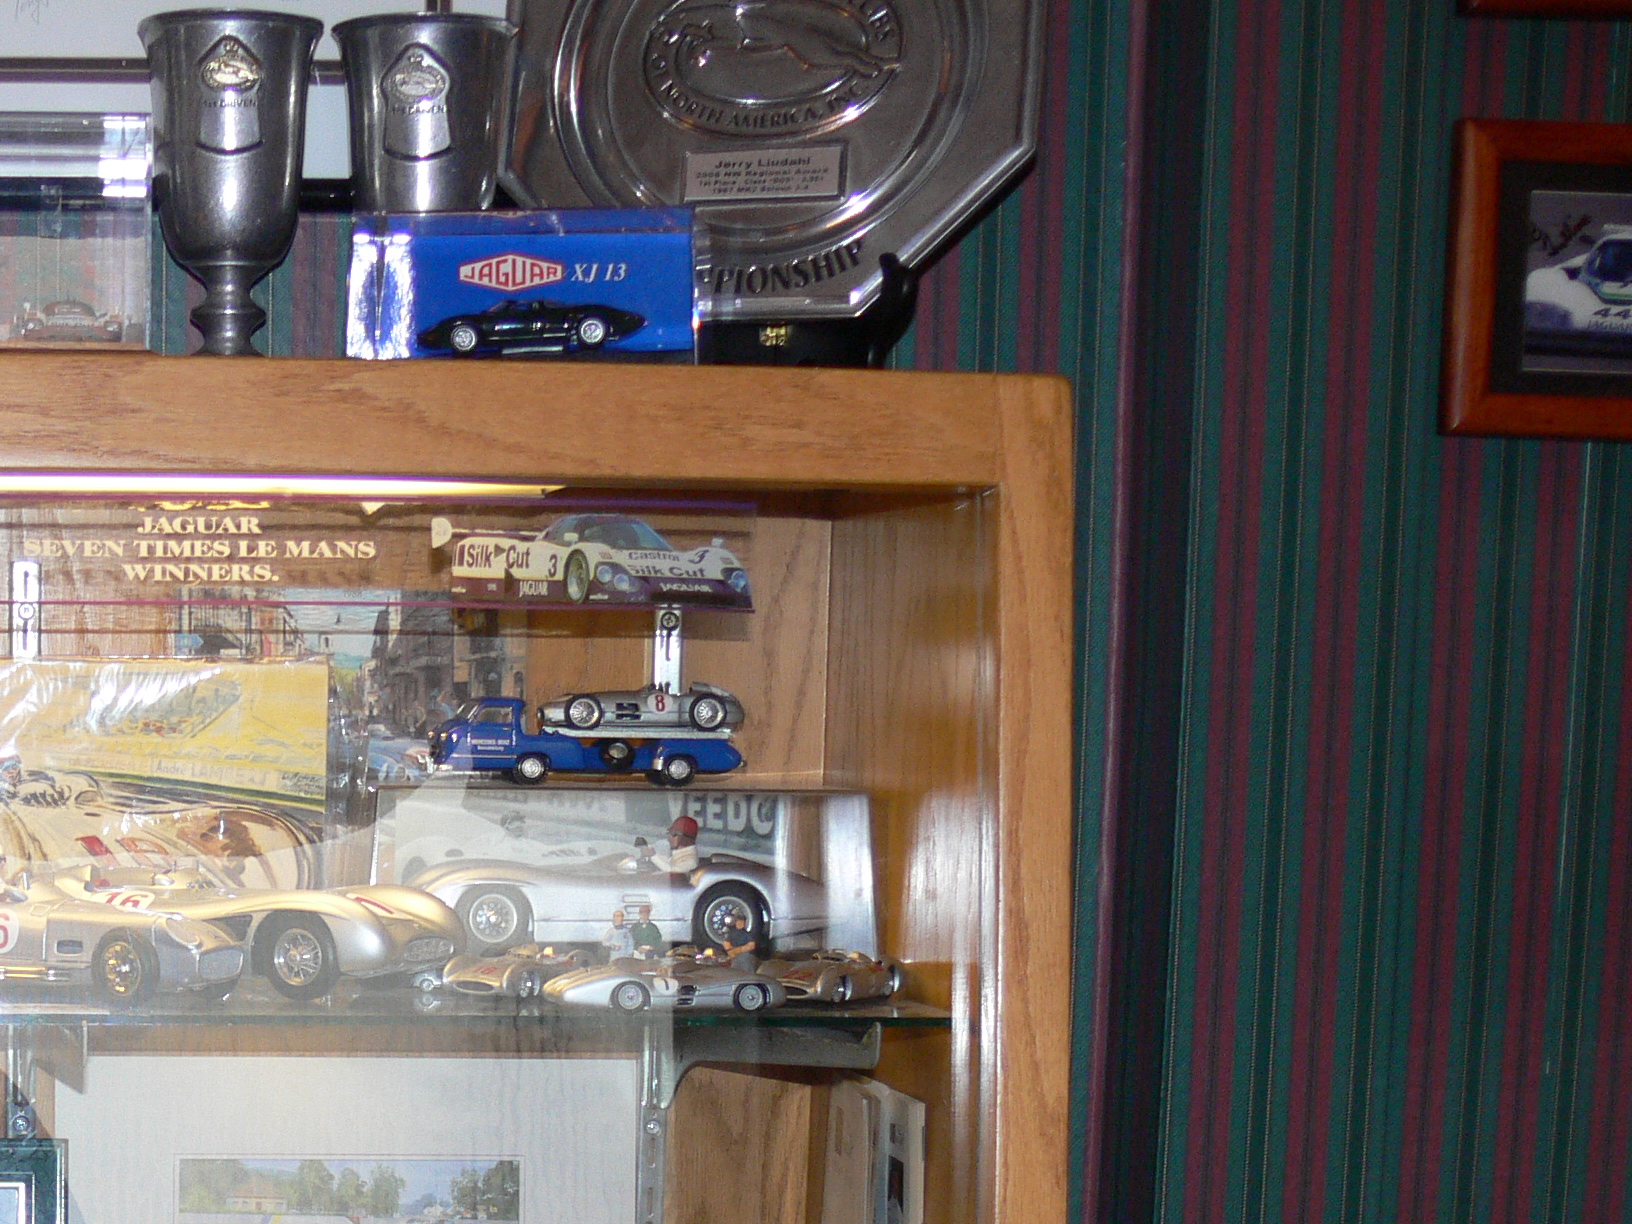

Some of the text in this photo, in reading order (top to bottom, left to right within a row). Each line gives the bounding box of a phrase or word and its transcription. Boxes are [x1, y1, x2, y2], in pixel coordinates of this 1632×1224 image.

[714, 158, 754, 170] Jerry
[462, 255, 628, 290] JAGUAR XJ 13
[1594, 307, 1632, 319] 44
[136, 516, 263, 535] JAGUAR
[23, 538, 377, 559] SEVEN TIMES LE MANS
[465, 543, 559, 577] Silk Cut 3
[120, 562, 281, 584] WINNERS.
[668, 564, 707, 579] Cut
[518, 580, 549, 599] JAGUAR
[655, 694, 667, 713] 8
